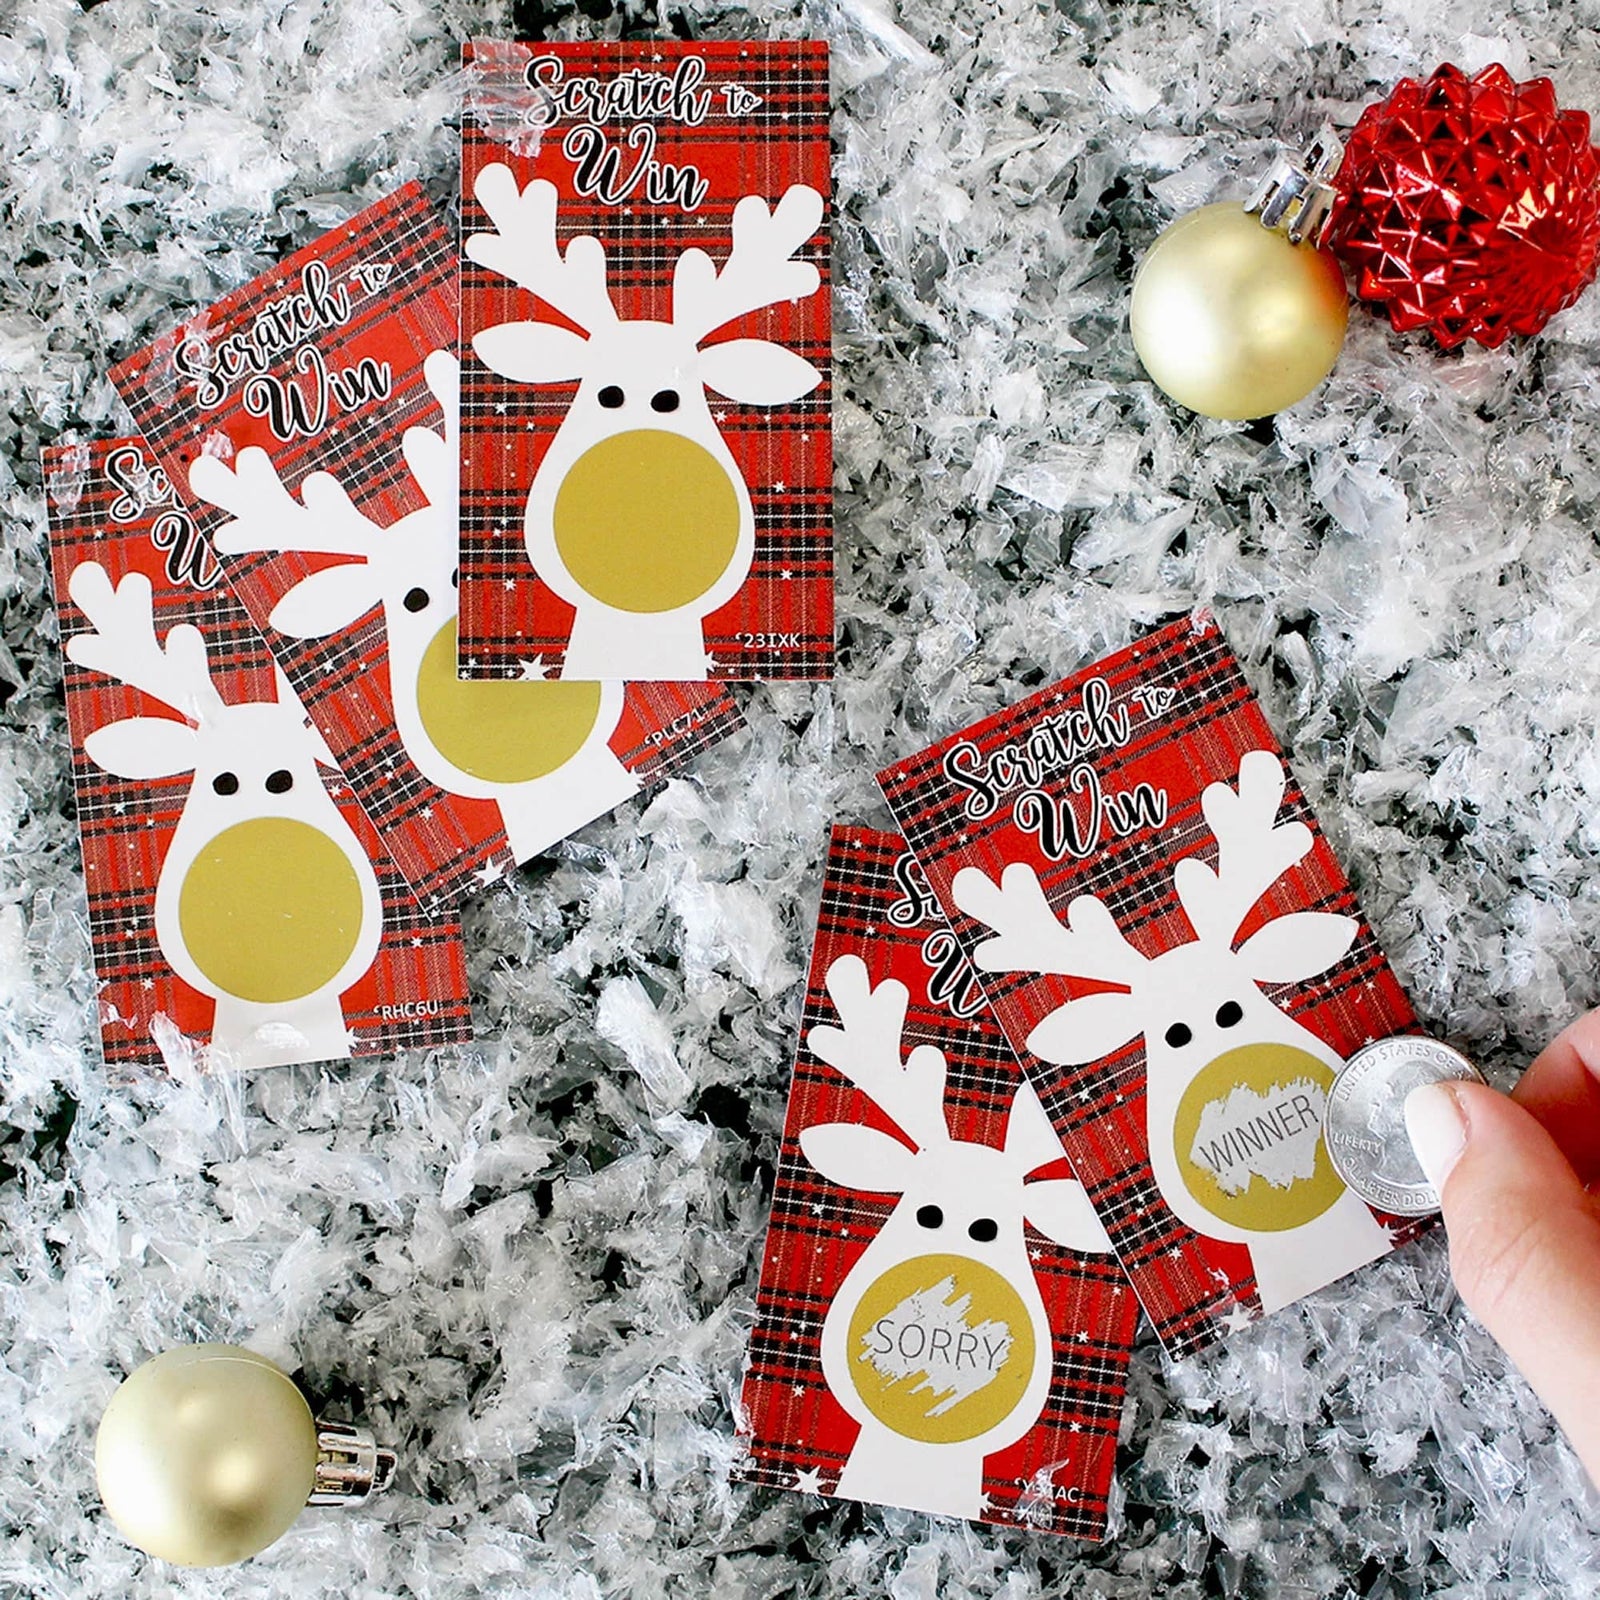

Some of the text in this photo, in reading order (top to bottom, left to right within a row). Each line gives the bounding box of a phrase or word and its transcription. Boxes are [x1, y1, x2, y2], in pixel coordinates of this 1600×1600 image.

[524, 55, 763, 127] Scratch to
[563, 123, 709, 212] Win
[174, 260, 393, 410] Scratch to
[243, 344, 392, 441] Win
[943, 677, 1177, 821] Scratch to
[1014, 763, 1168, 861] Win
[1335, 1043, 1458, 1102] UNITED STATES OF
[1198, 1094, 1319, 1173] WINNER
[1333, 1132, 1382, 1156] LIBERTY
[873, 1319, 1006, 1370] SORRY
